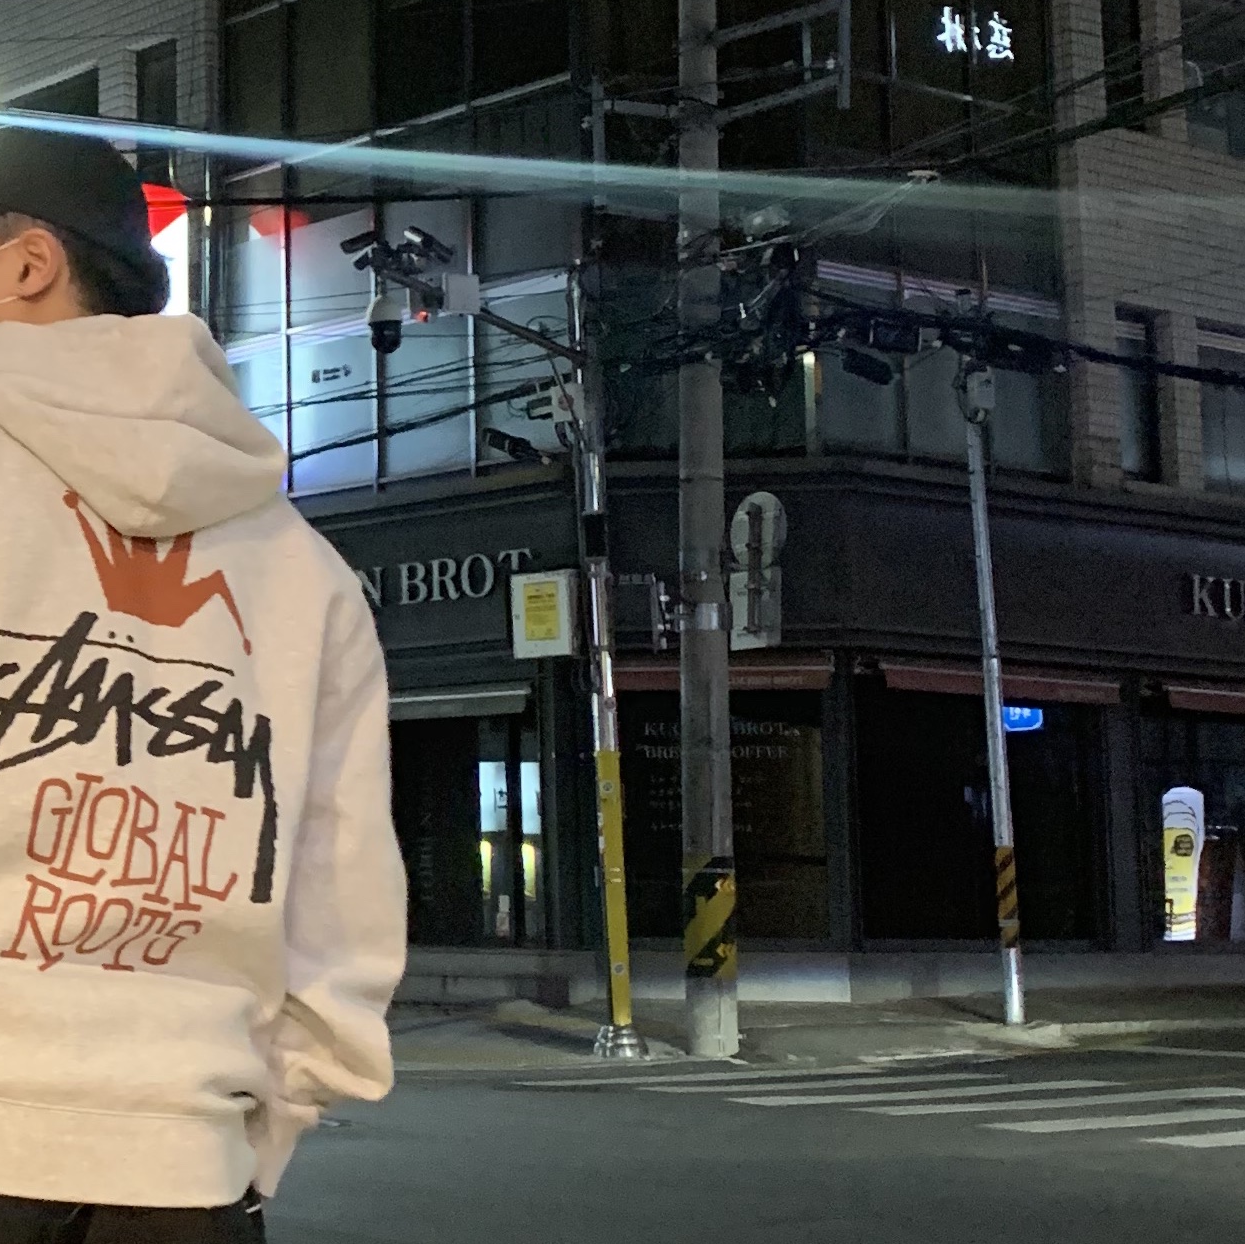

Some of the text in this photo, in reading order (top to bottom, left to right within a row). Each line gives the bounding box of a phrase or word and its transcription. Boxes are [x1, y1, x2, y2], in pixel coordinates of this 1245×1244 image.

[398, 549, 532, 605] BROT
[26, 771, 240, 911] GLOBAL
[0, 873, 205, 972] ROOTS
